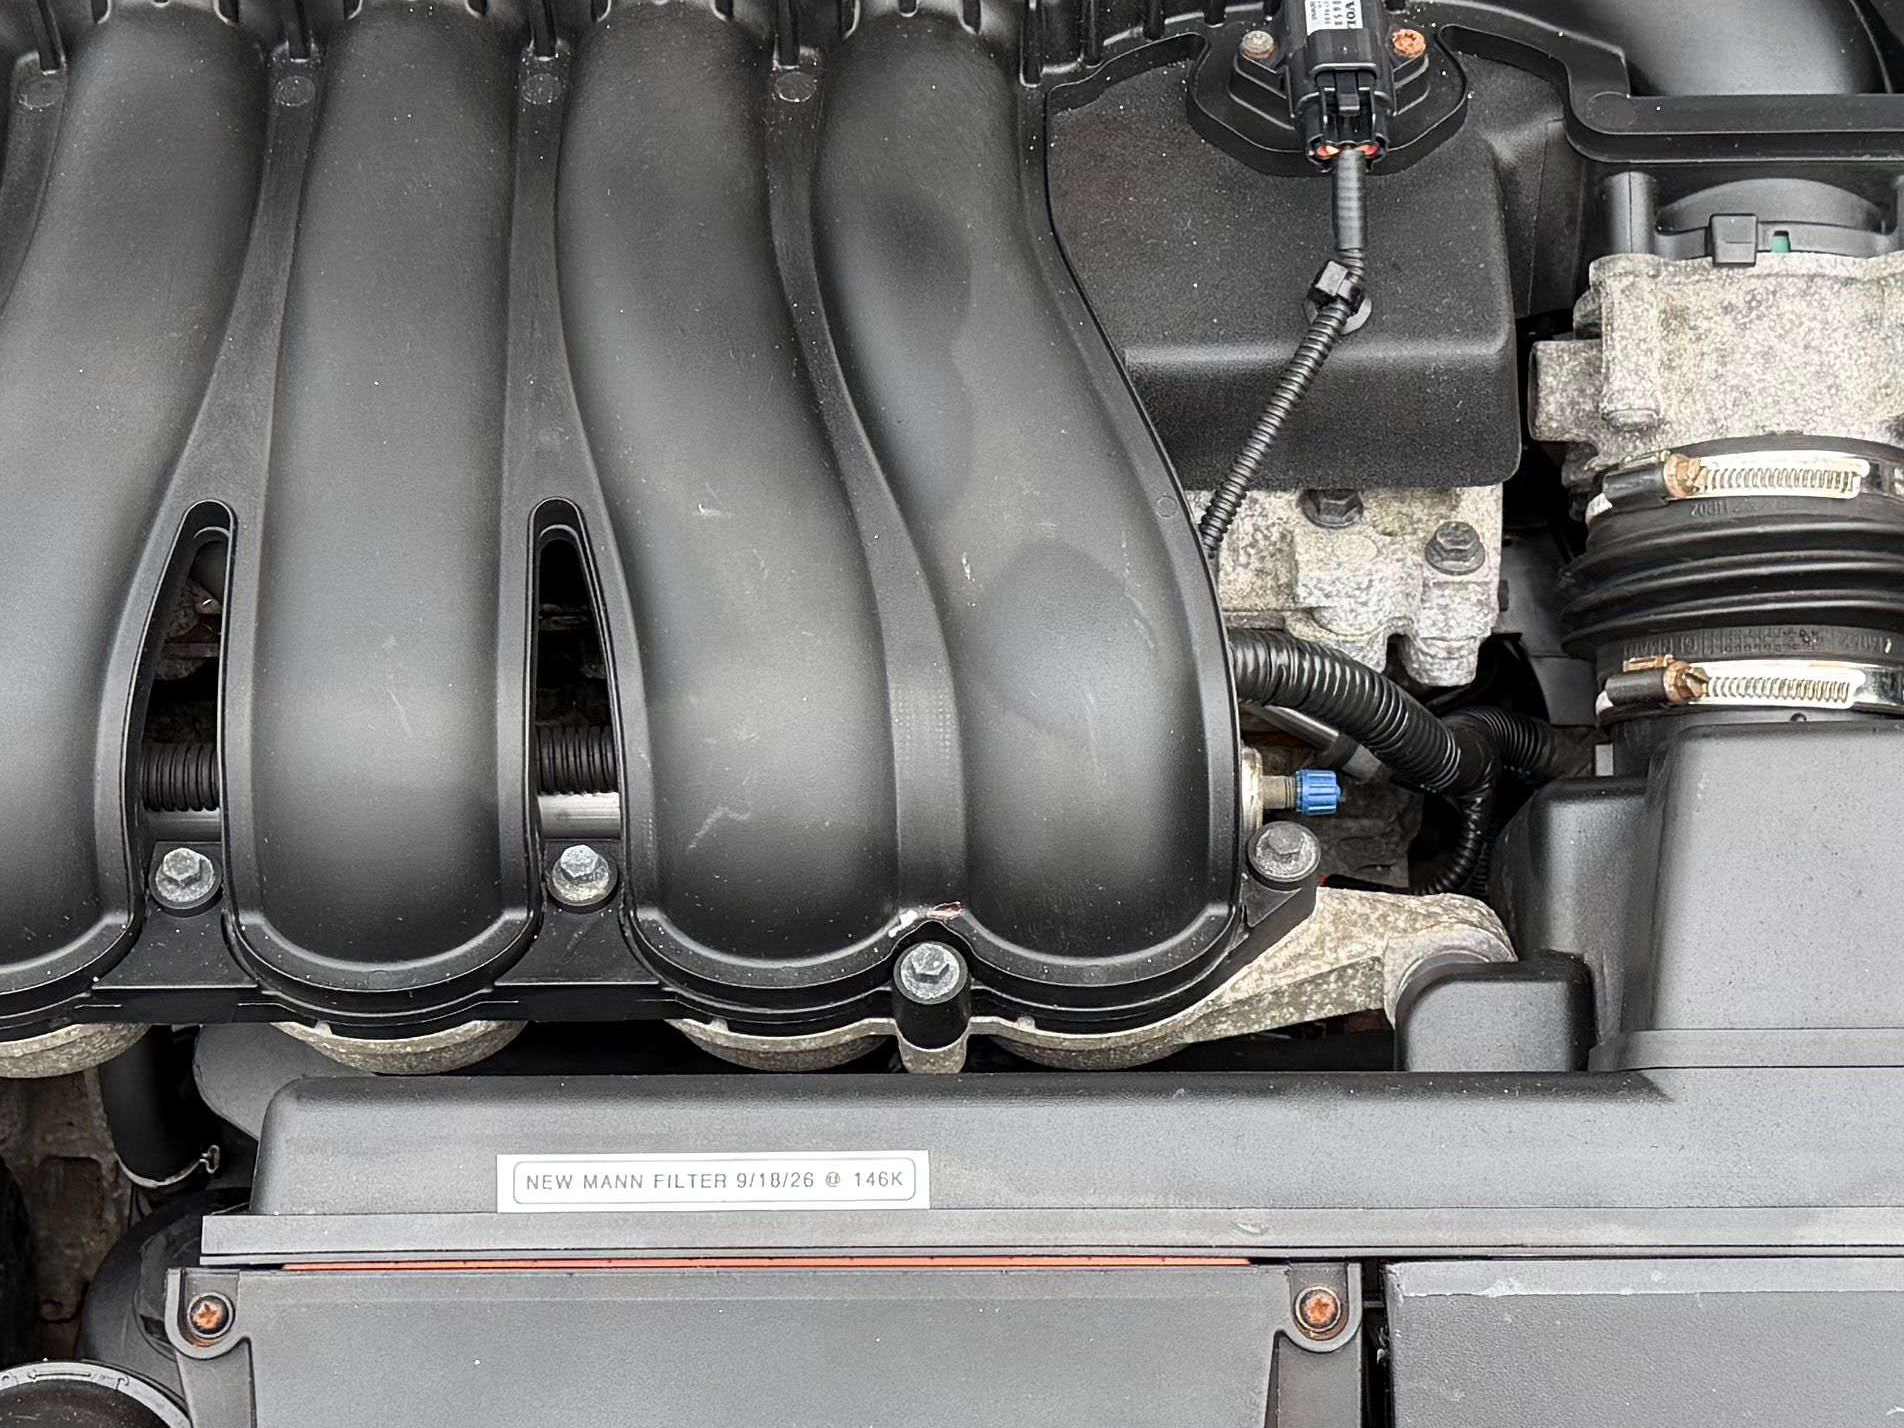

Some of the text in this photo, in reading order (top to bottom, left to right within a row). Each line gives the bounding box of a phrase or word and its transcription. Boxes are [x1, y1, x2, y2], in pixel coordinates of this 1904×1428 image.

[526, 1170, 903, 1189] NEW MANN FILTER 9/18/26 @ 146K
